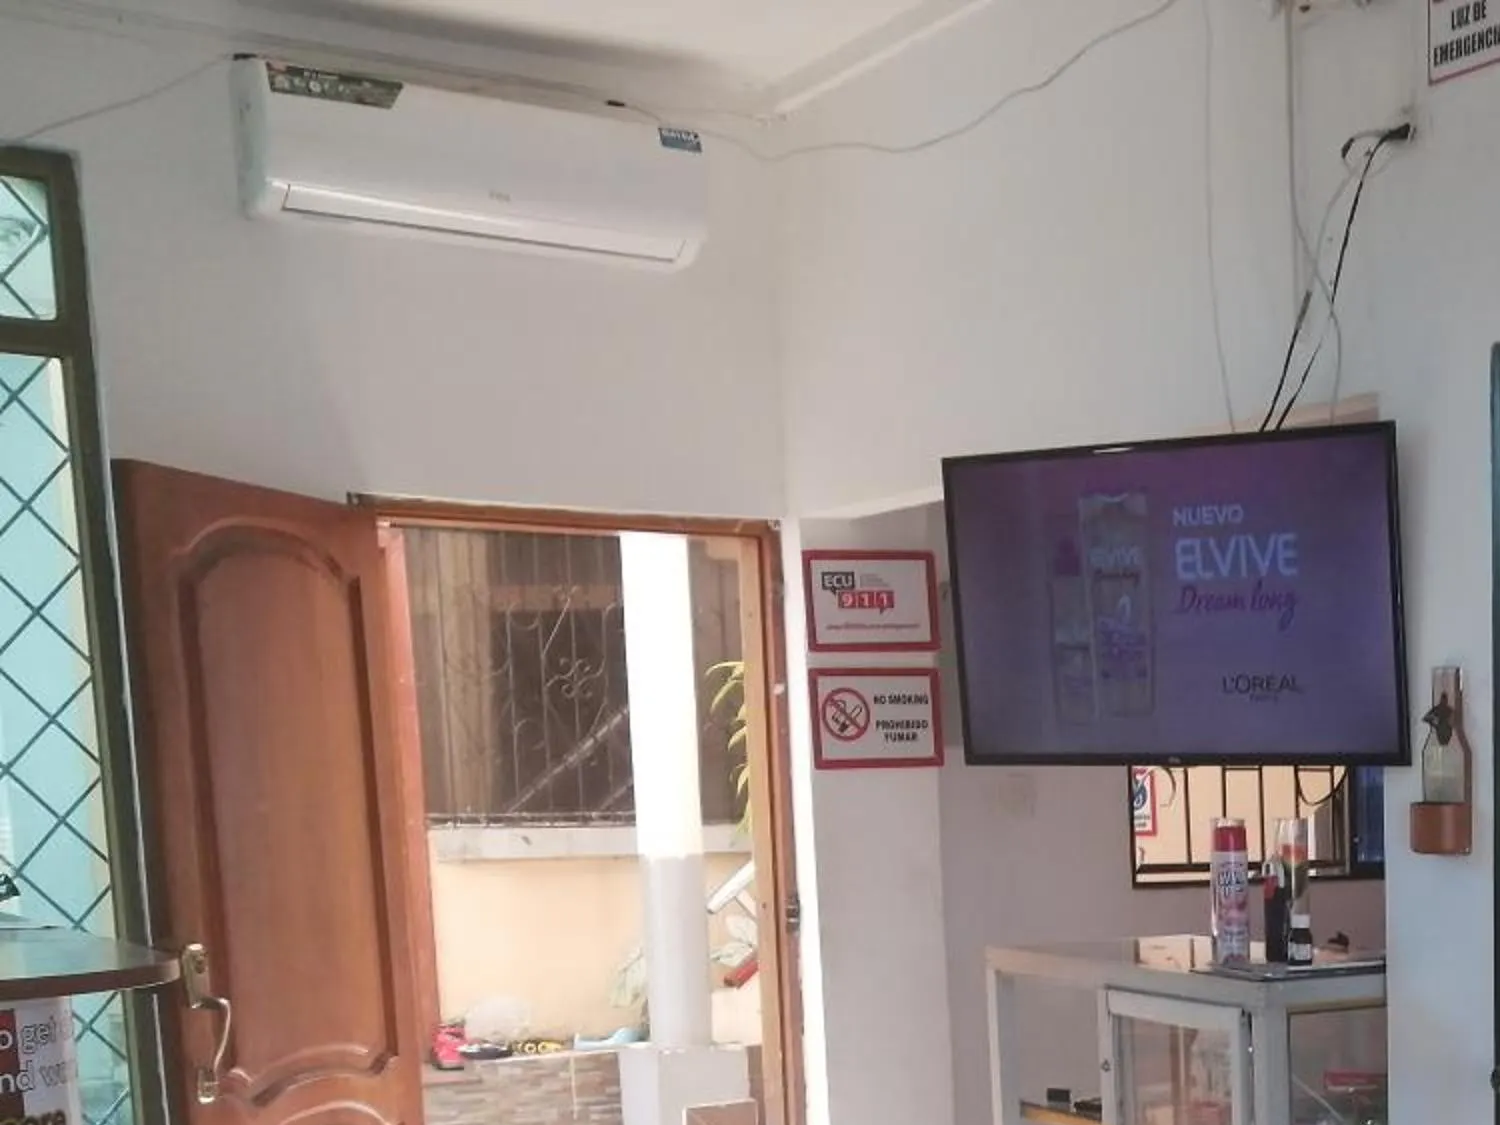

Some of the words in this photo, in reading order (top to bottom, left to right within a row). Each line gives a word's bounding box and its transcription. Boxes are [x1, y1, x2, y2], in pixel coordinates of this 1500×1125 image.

[1451, 5, 1470, 31] LUZ
[1473, 0, 1487, 21] DE
[1172, 503, 1244, 527] NUEVO
[1175, 533, 1298, 580] ELVIVE
[824, 574, 853, 588] ECU
[841, 592, 889, 607] 911
[873, 694, 886, 705] NO
[888, 692, 929, 705] SMOKING
